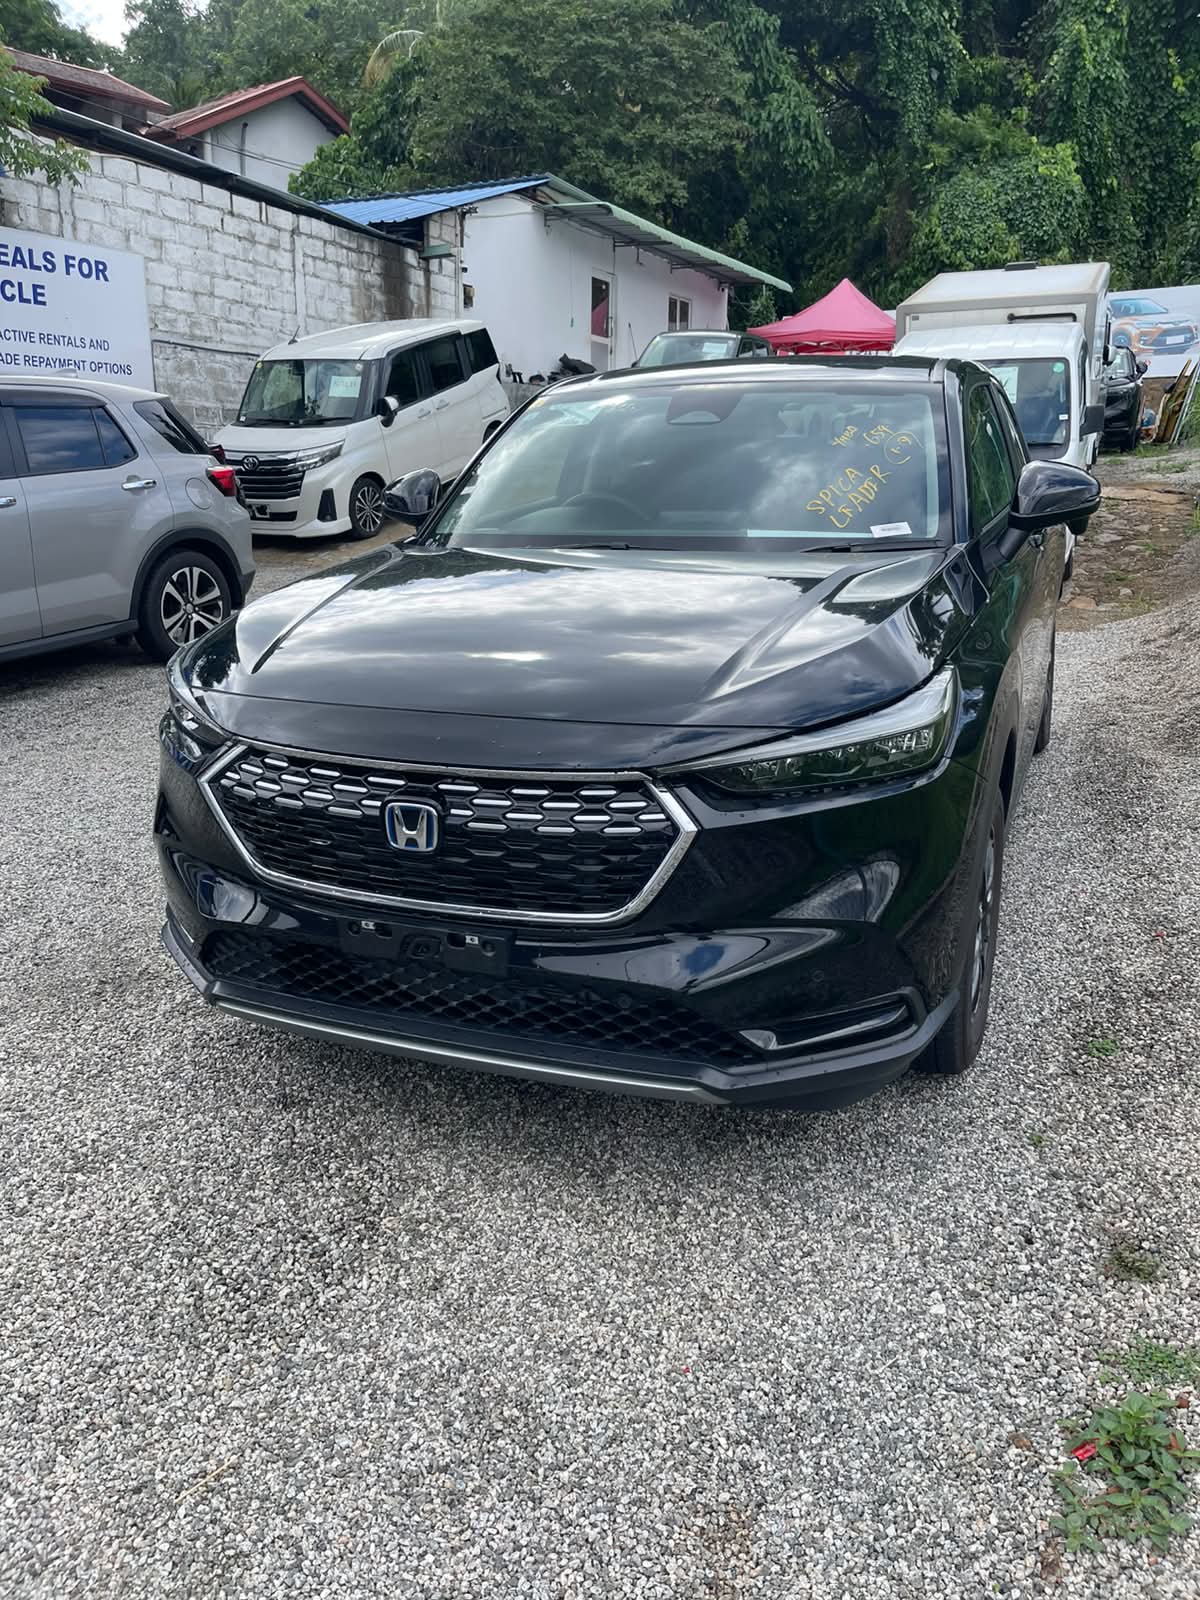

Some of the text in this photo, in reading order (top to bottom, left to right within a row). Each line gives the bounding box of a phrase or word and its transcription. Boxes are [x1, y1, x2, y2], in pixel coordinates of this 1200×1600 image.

[64, 254, 109, 282] FOR
[0, 279, 47, 306] CLE
[39, 332, 86, 349] RENTALS
[89, 338, 110, 351] AND
[23, 354, 86, 372] REPAYMENT
[89, 360, 133, 376] OPTIONS
[806, 467, 863, 515] SPICA
